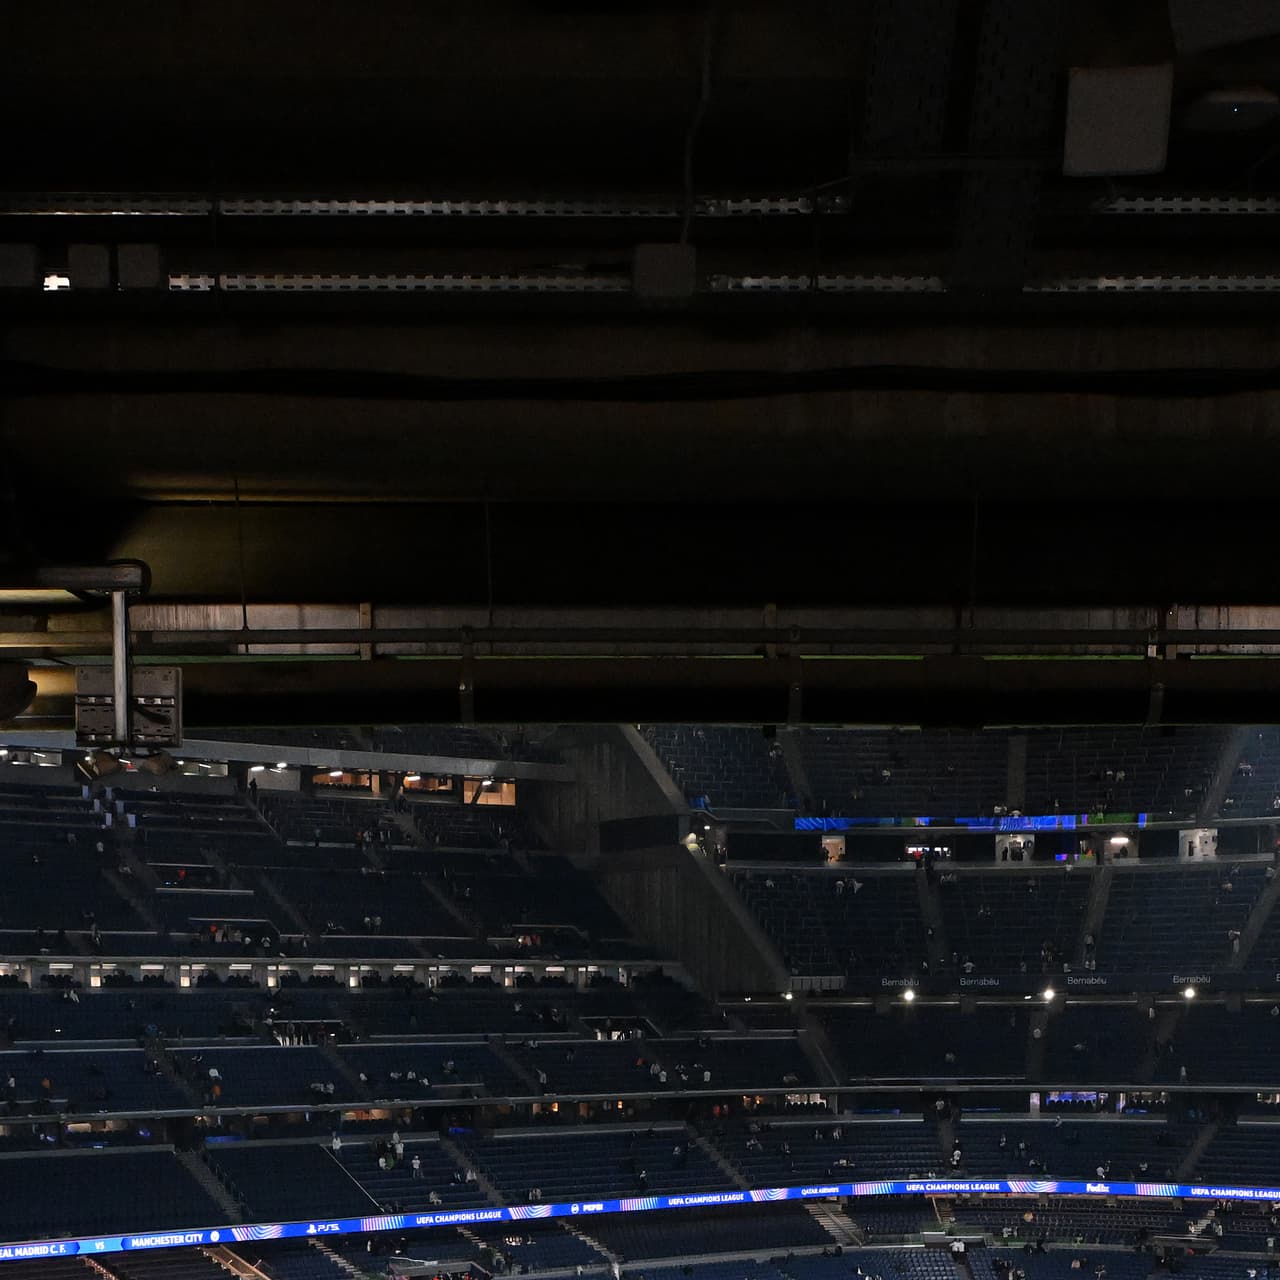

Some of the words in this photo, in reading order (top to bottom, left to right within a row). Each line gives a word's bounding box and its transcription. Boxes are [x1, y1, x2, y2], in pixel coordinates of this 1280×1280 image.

[925, 1183, 970, 1191] CHAMPIONS
[971, 1183, 1000, 1191] LEAGUE
[1191, 1188, 1209, 1196] UEFA
[1211, 1189, 1254, 1198] CHAMPIONS
[668, 1196, 684, 1205] UEFA
[684, 1194, 720, 1205] CHAMPIONS
[721, 1193, 744, 1202] LEAGUE
[416, 1215, 434, 1225] UEFA
[434, 1212, 475, 1224] CHAMPIONS
[476, 1210, 502, 1220] LEAGUE
[94, 1241, 105, 1251] VS
[131, 1235, 185, 1248] MANCHESTER
[185, 1233, 203, 1243] CITY
[14, 1245, 49, 1257] MADRID
